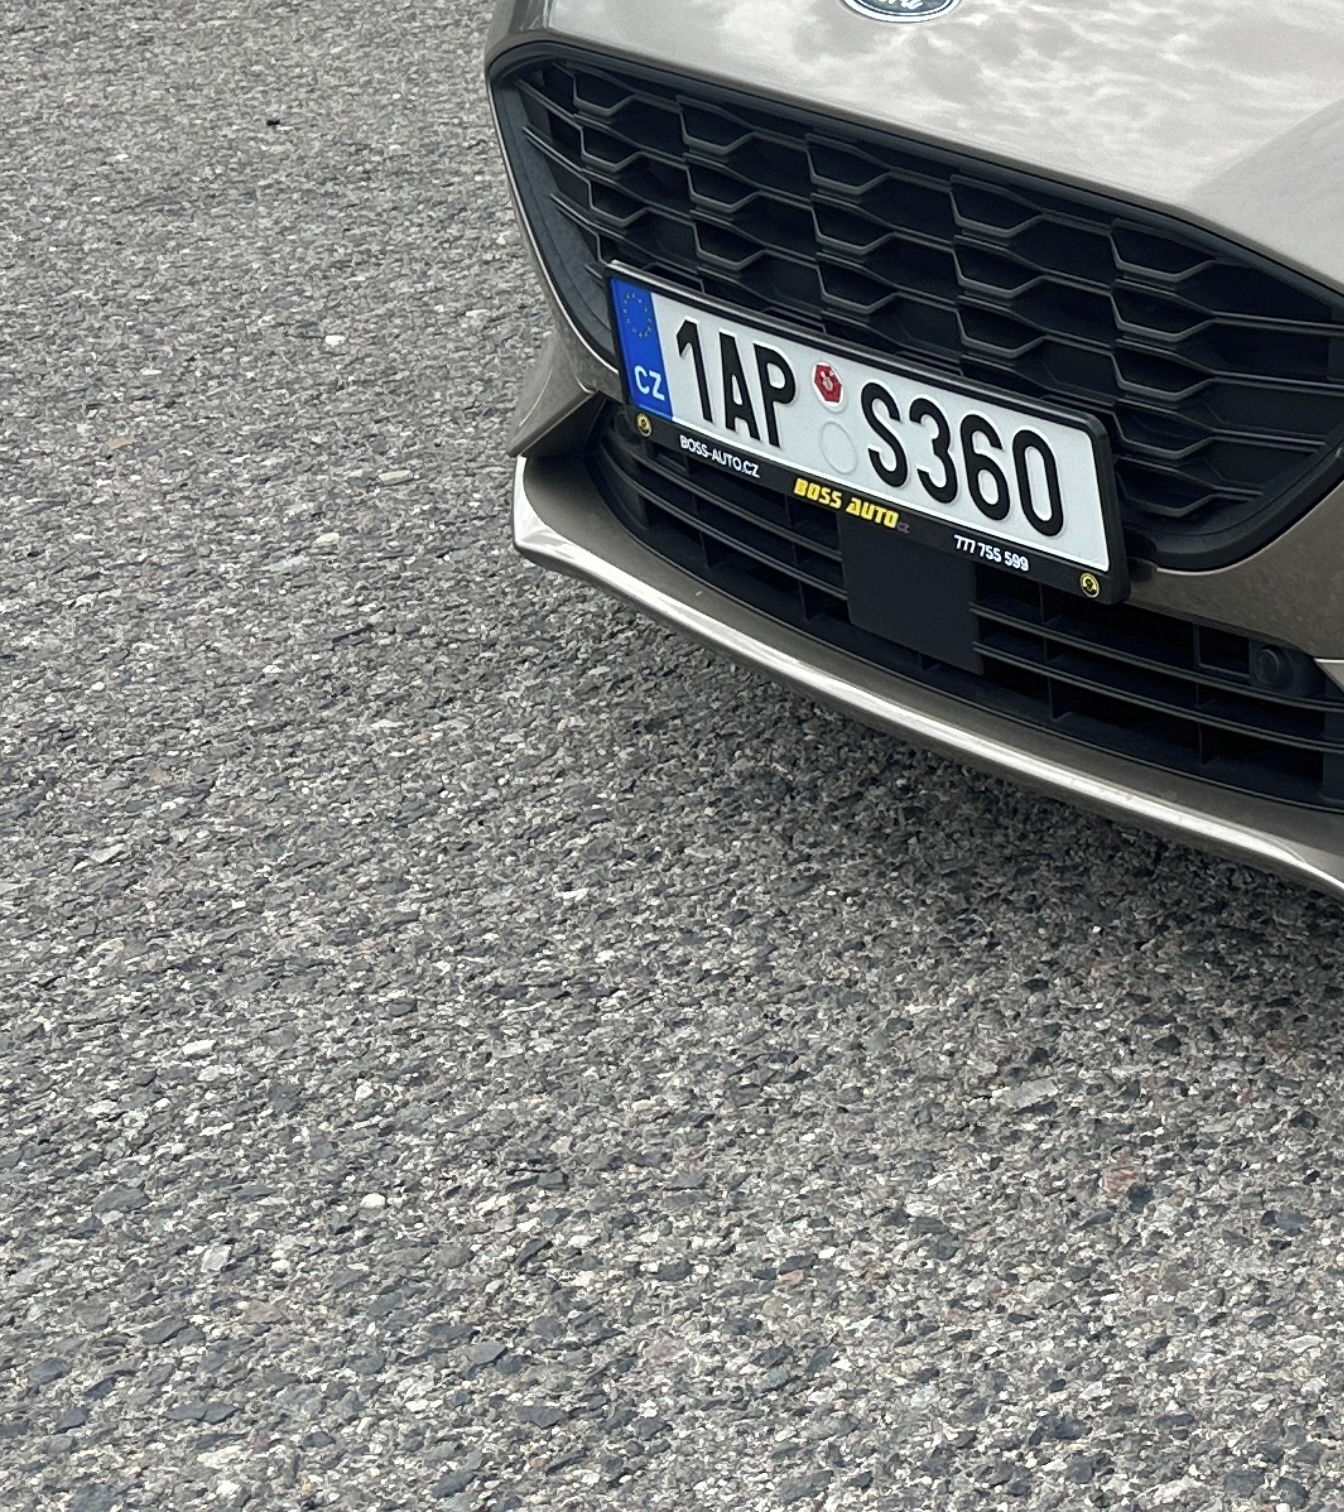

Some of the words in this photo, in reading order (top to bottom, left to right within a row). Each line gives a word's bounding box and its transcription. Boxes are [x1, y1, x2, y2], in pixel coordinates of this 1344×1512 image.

[633, 364, 666, 402] CZ
[676, 319, 797, 449] 1AP
[860, 381, 1065, 538] S360
[680, 434, 760, 479] BOSS-AUTO.CZ
[793, 477, 842, 509] BOSS
[845, 497, 899, 529] AUTO
[953, 534, 977, 554] 777
[977, 542, 1002, 563] 755
[1004, 551, 1030, 572] 599
